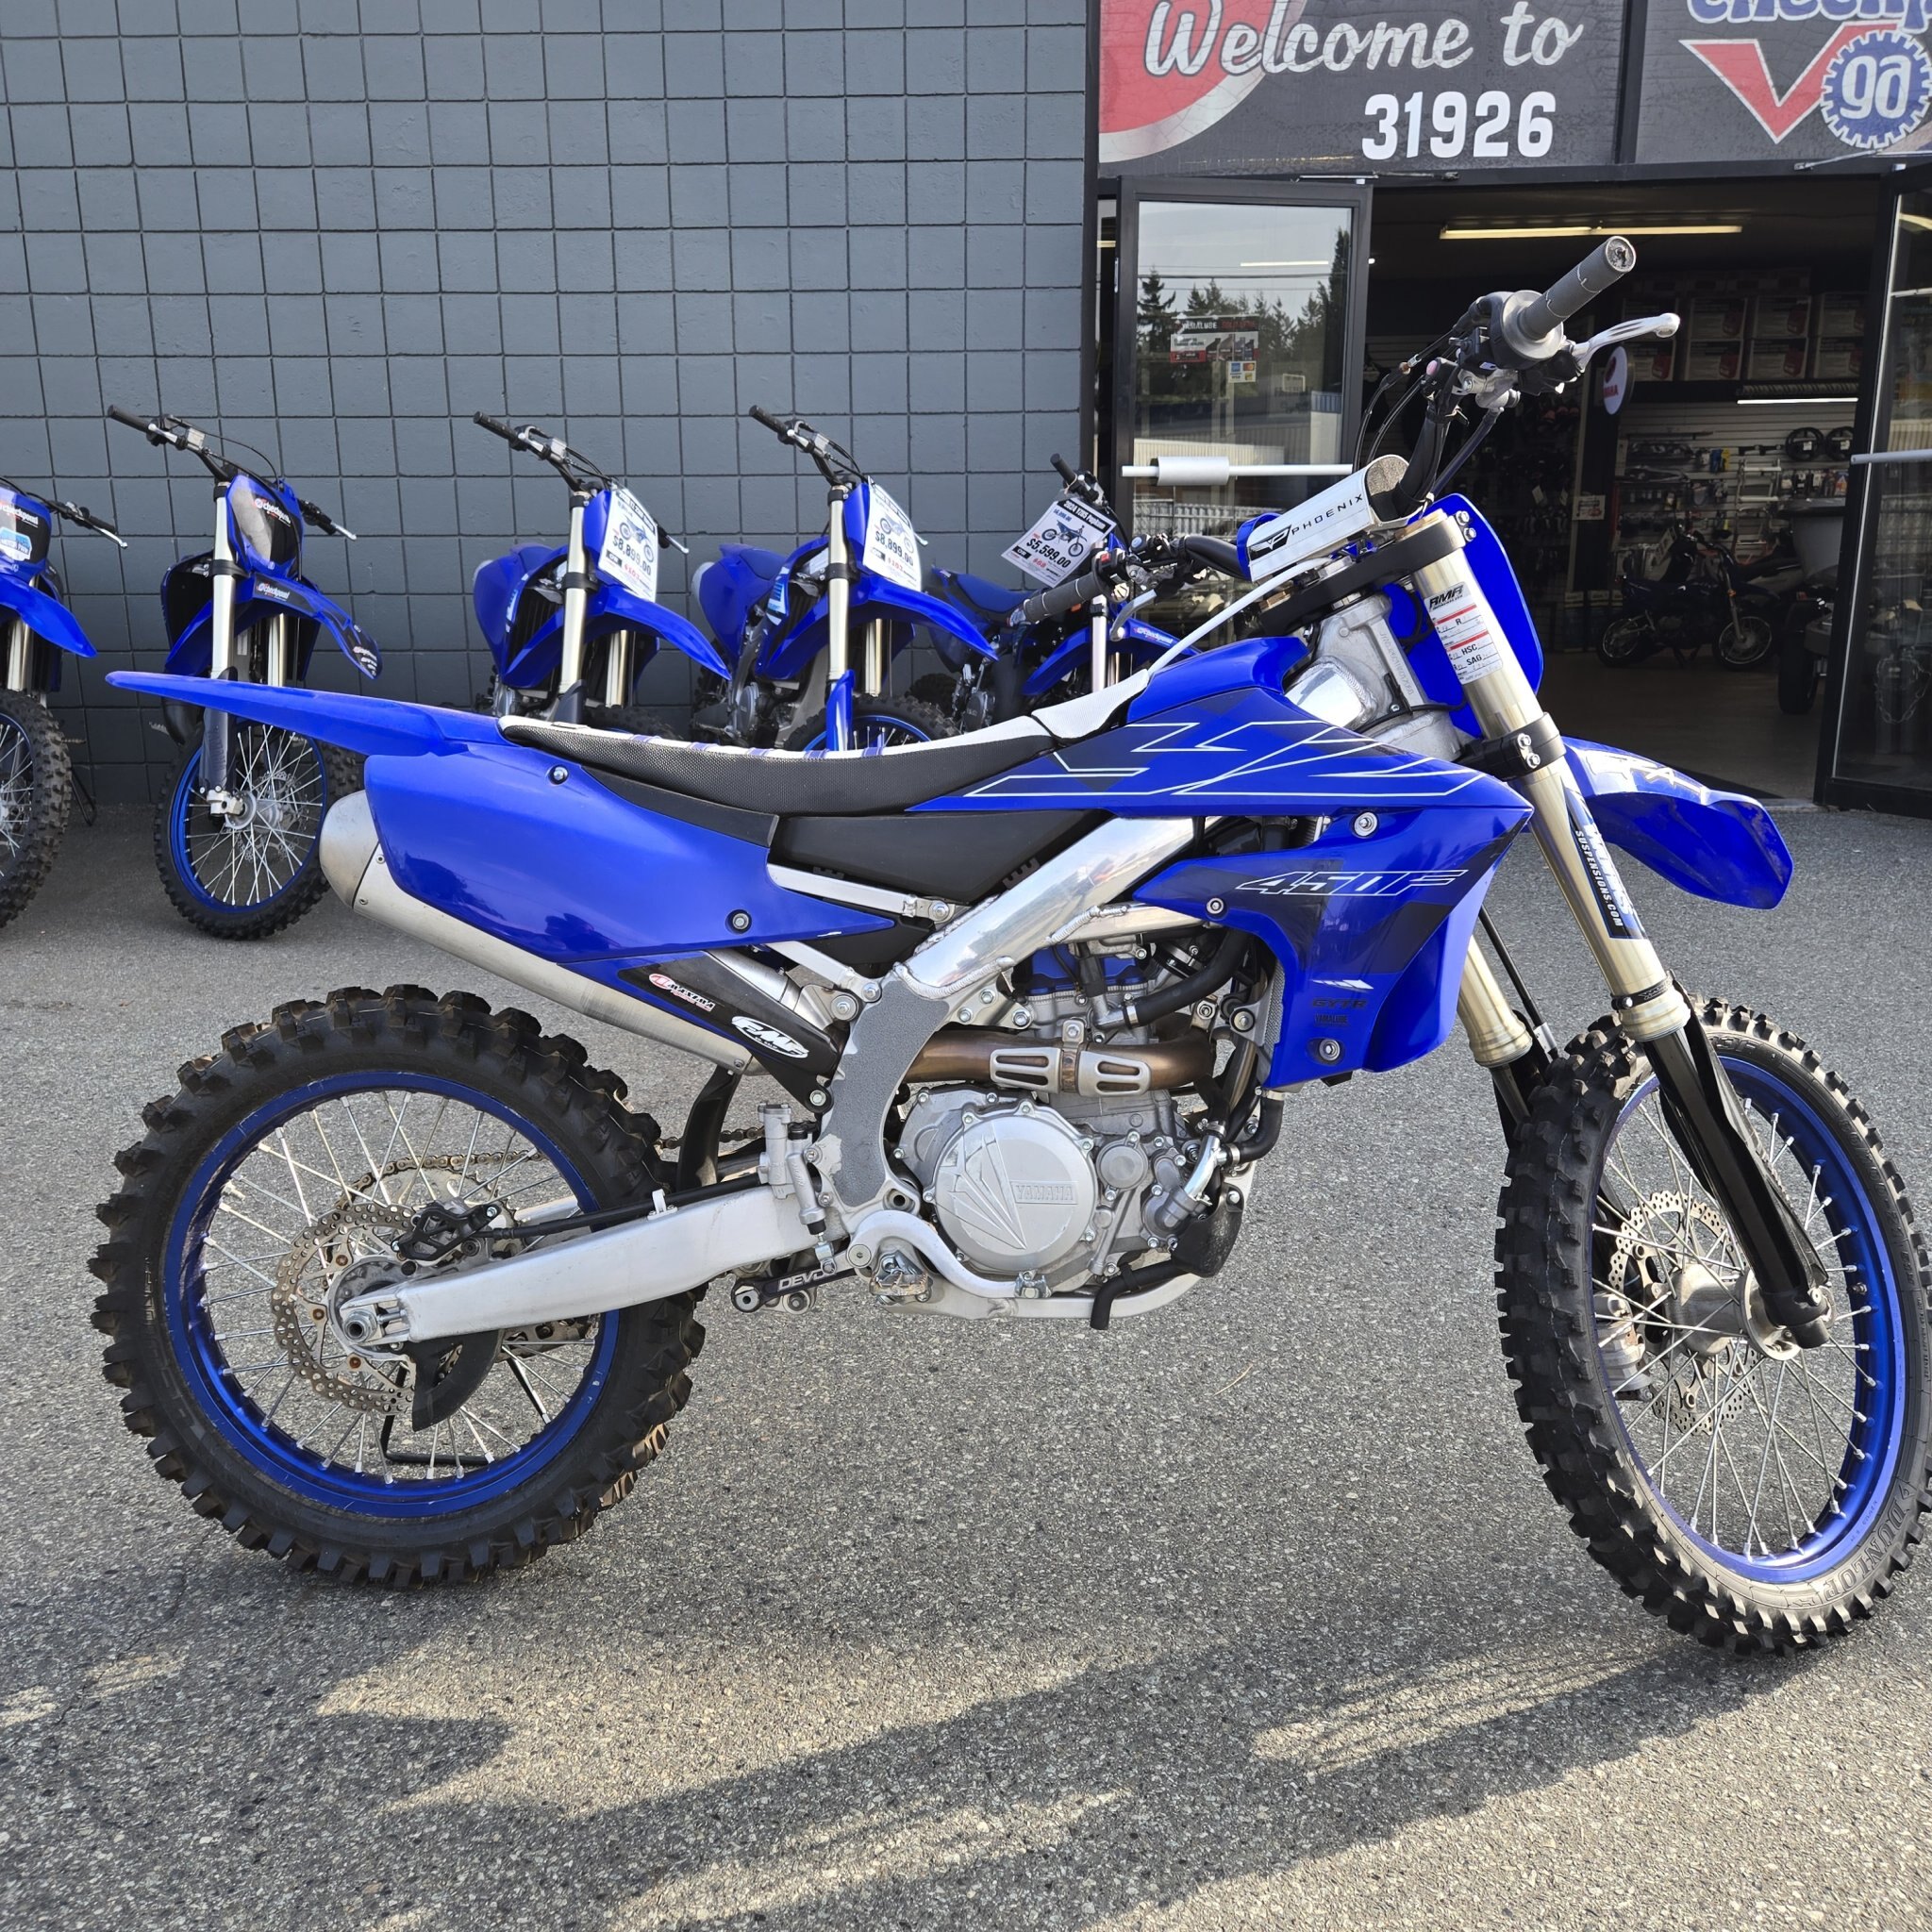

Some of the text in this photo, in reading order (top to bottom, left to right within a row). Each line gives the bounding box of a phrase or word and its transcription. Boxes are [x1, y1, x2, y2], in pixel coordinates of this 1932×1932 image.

[1144, 0, 1584, 75] Welcome to
[1361, 91, 1557, 160] 31926
[1291, 493, 1363, 536] PHOENIX
[612, 535, 651, 576] $8,899.00
[874, 530, 914, 566] $8,899.00
[1026, 538, 1072, 569] $5,599.00
[1461, 644, 1478, 656] HSC
[1466, 655, 1483, 666] SAG
[1235, 870, 1469, 896] 450F
[1575, 830, 1624, 926] SUSPENSIONS.COM
[1312, 998, 1368, 1008] GYTR
[732, 1019, 809, 1054] FMF
[1015, 1184, 1074, 1201] YAMAHA
[1822, 1498, 1911, 1603] DUNLOP
